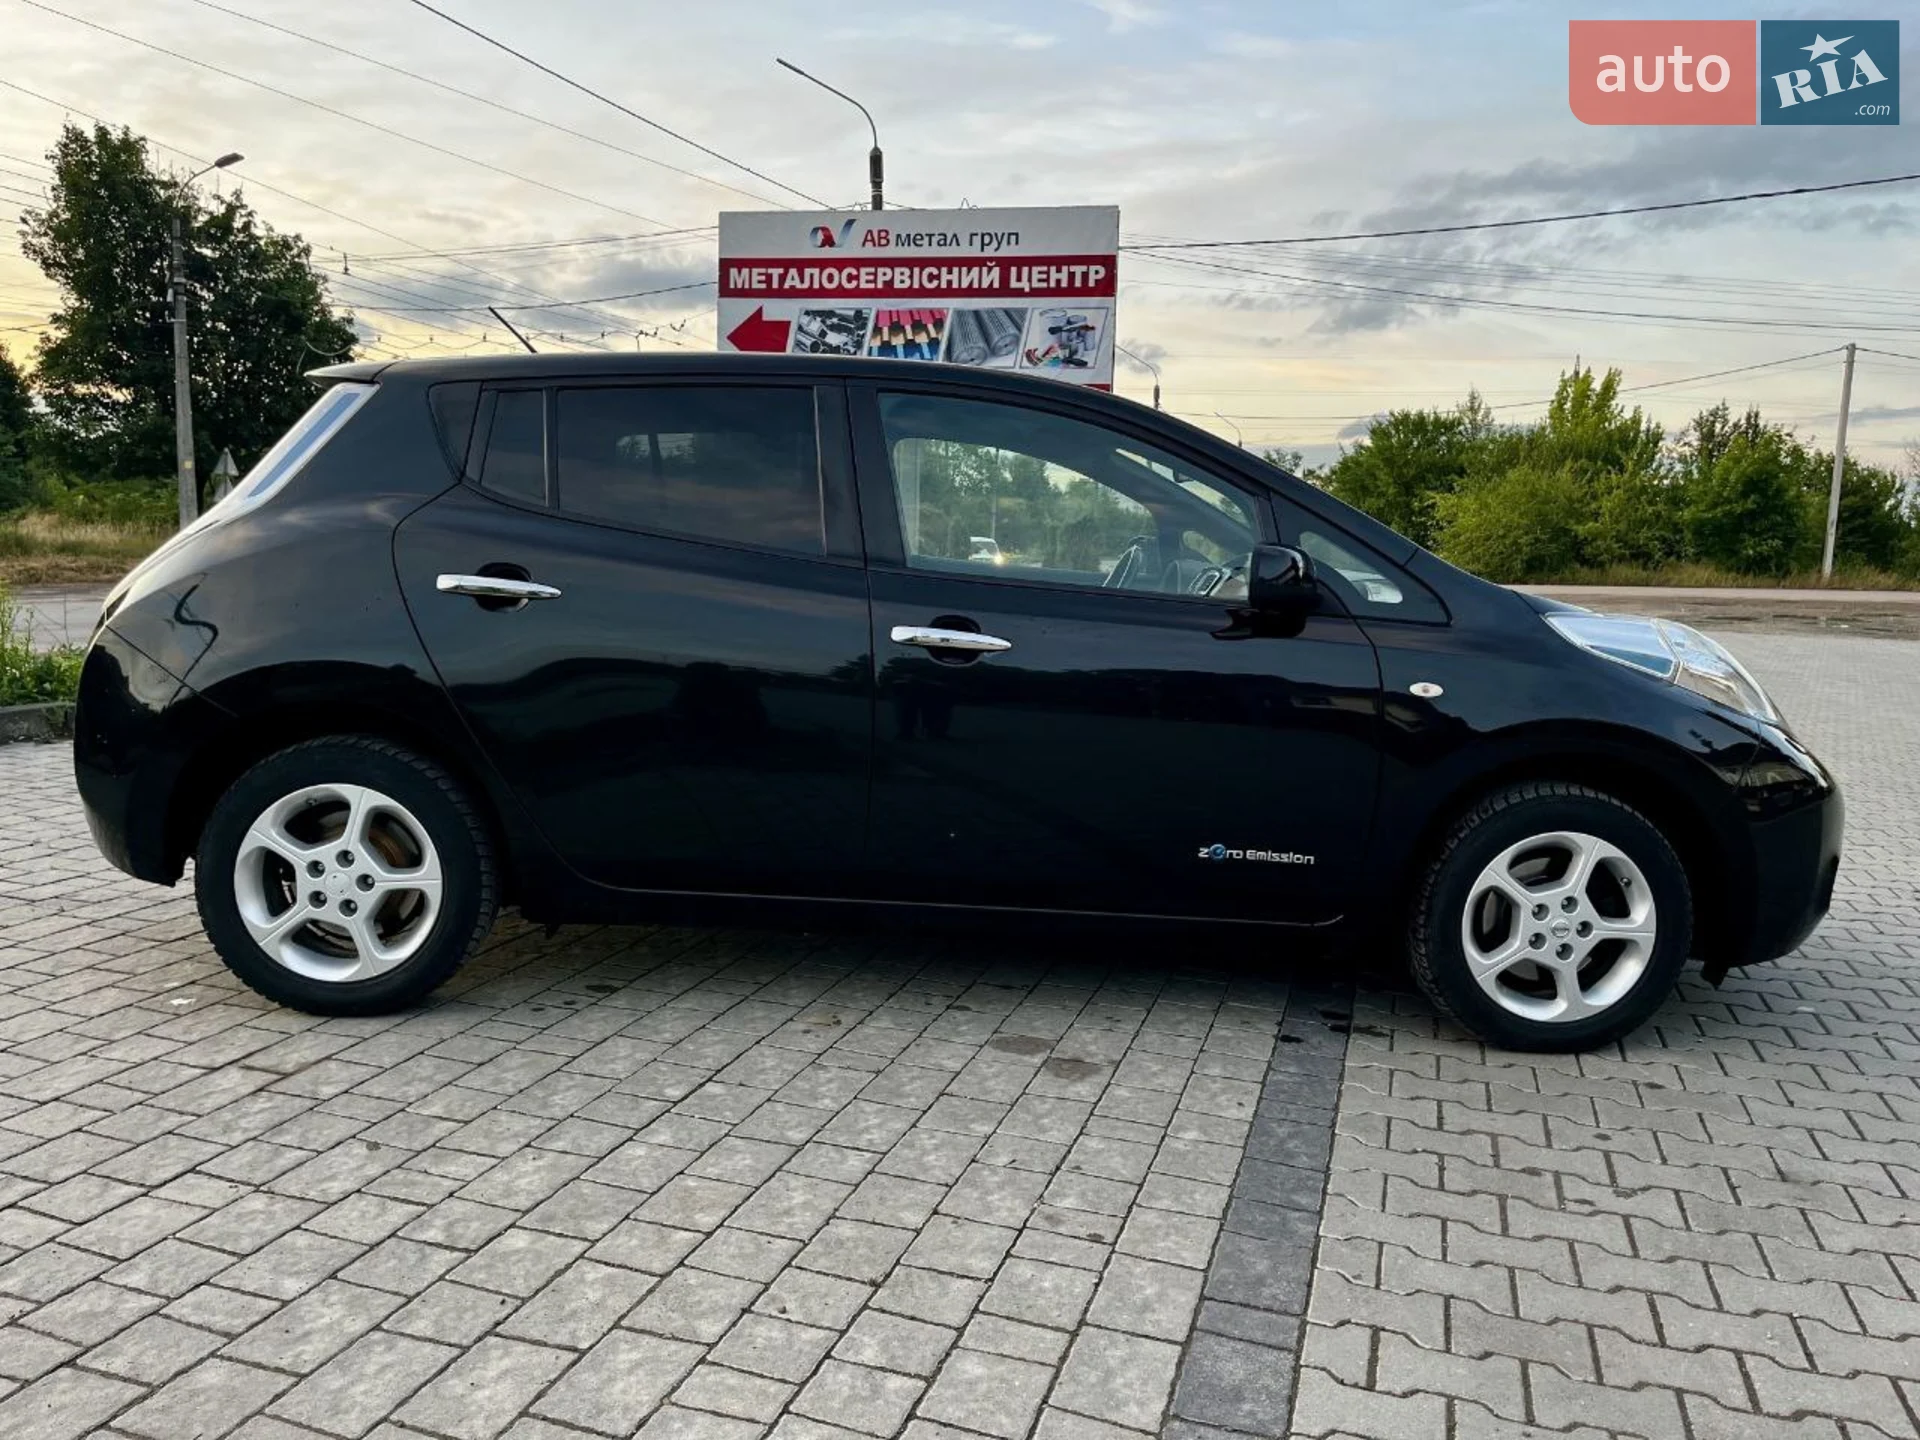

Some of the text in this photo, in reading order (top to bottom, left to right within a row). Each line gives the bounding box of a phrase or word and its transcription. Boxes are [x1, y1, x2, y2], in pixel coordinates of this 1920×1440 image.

[895, 233, 960, 248] метал
[968, 231, 1020, 252] груп
[728, 261, 1107, 293] МЕТАЛОСЕРВІСНИЙ ЦЕНТР
